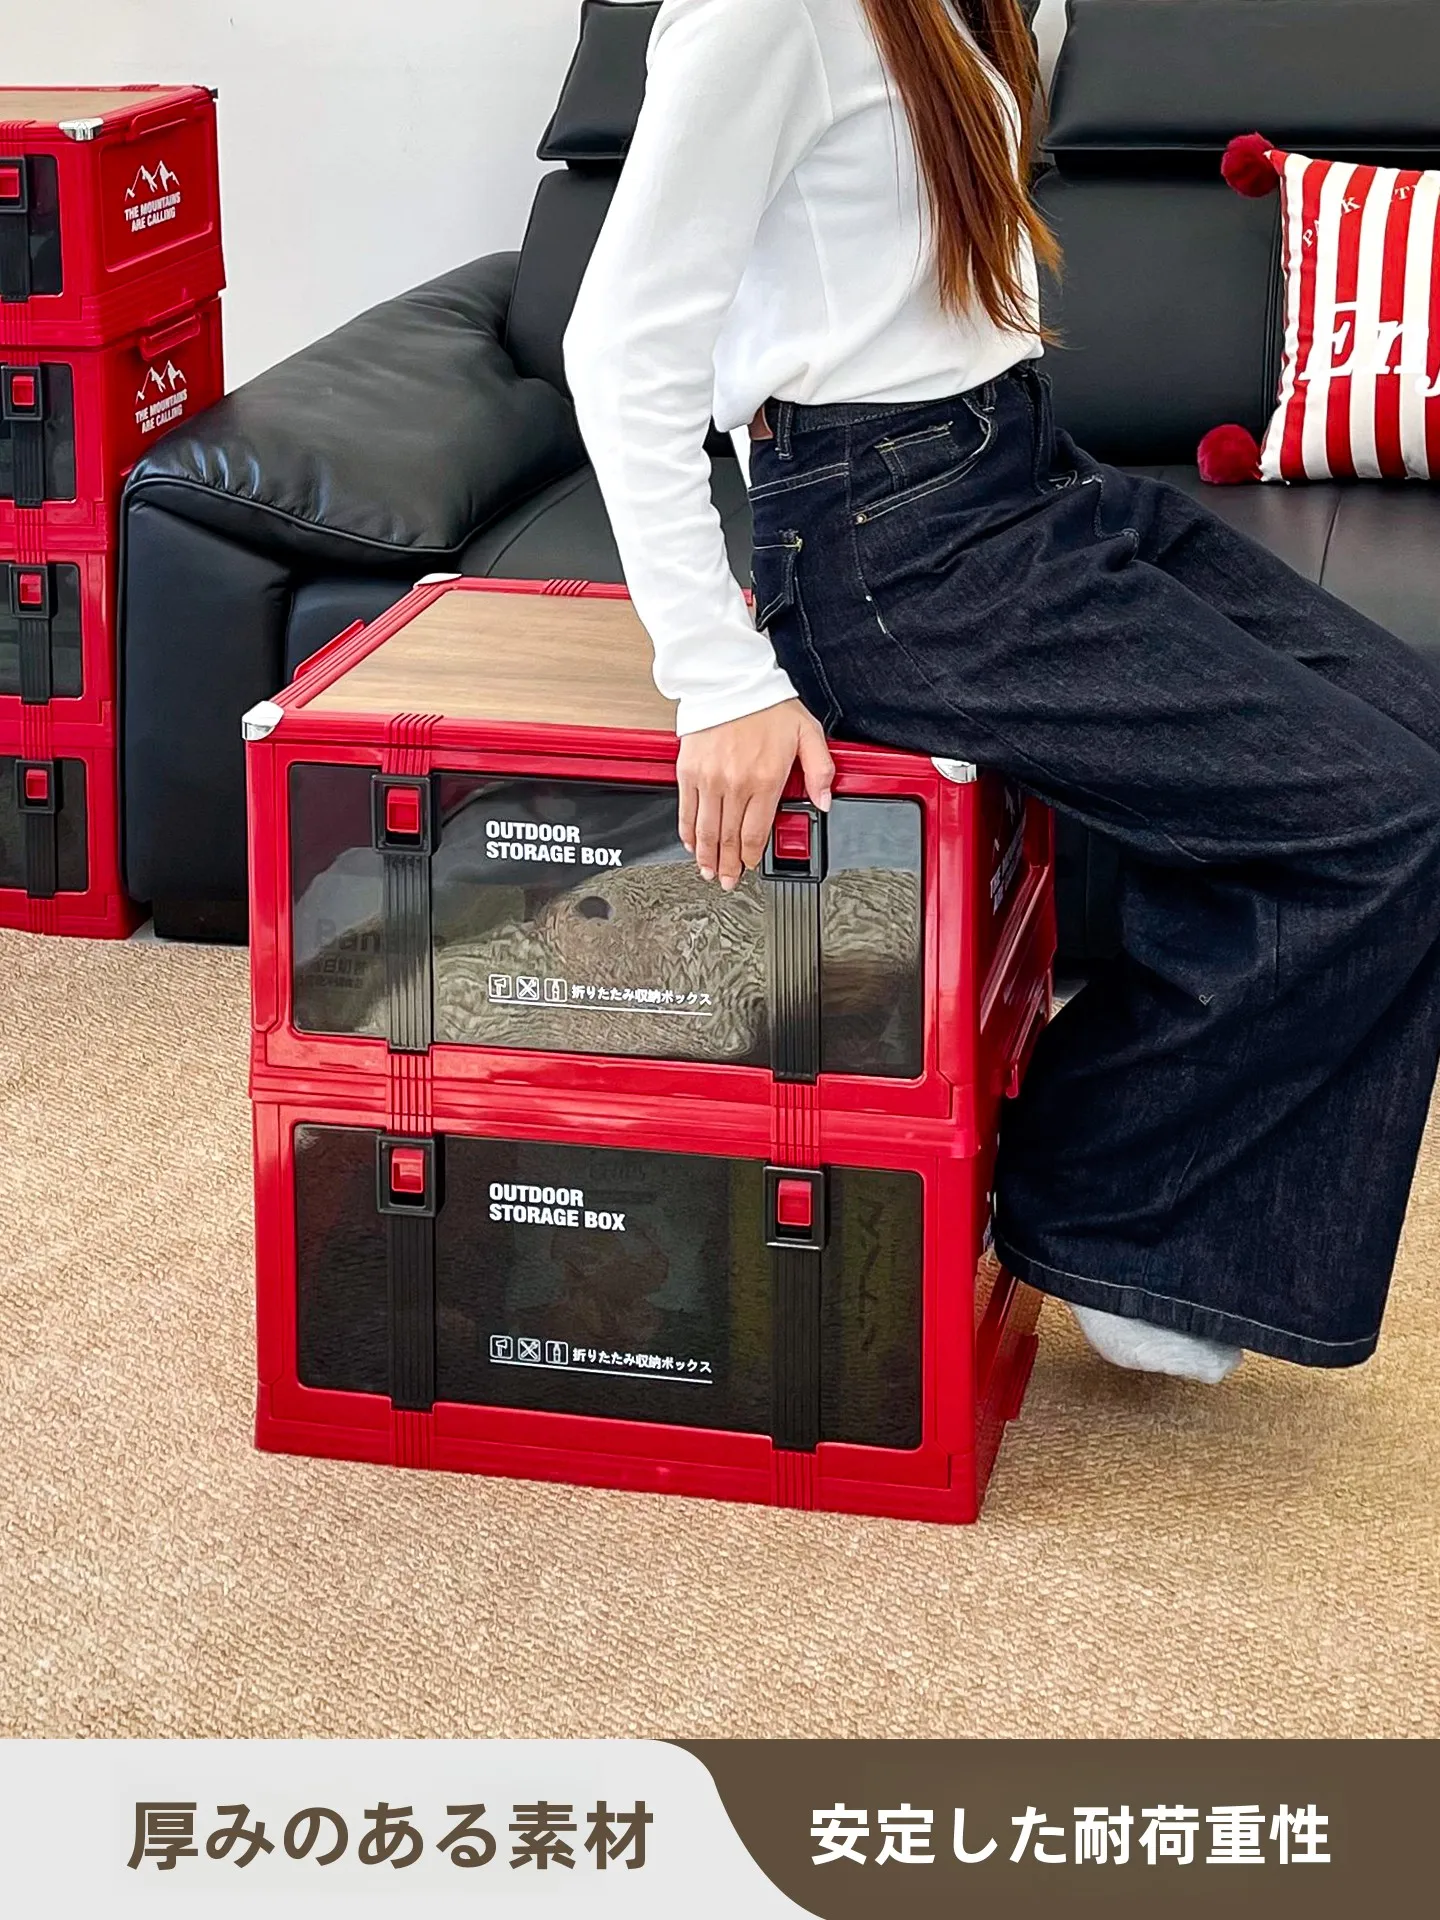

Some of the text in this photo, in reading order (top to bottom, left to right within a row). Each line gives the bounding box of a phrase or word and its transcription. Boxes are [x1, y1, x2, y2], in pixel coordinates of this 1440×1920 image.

[124, 191, 181, 221] THE MOUNTAINS
[131, 206, 176, 232] ARE CALLING
[135, 388, 188, 424] THE MOUNTAINS
[141, 403, 183, 434] ARE CALLING
[485, 820, 580, 843] OUTDOOR
[486, 841, 623, 866] STORAGE BOX
[571, 984, 712, 1006] 折りたたみ収納ボックス
[489, 1182, 584, 1207] OUTDOOR
[489, 1203, 626, 1231] STORAGE BOX
[572, 1347, 713, 1373] 折りたたみ収納ボックス
